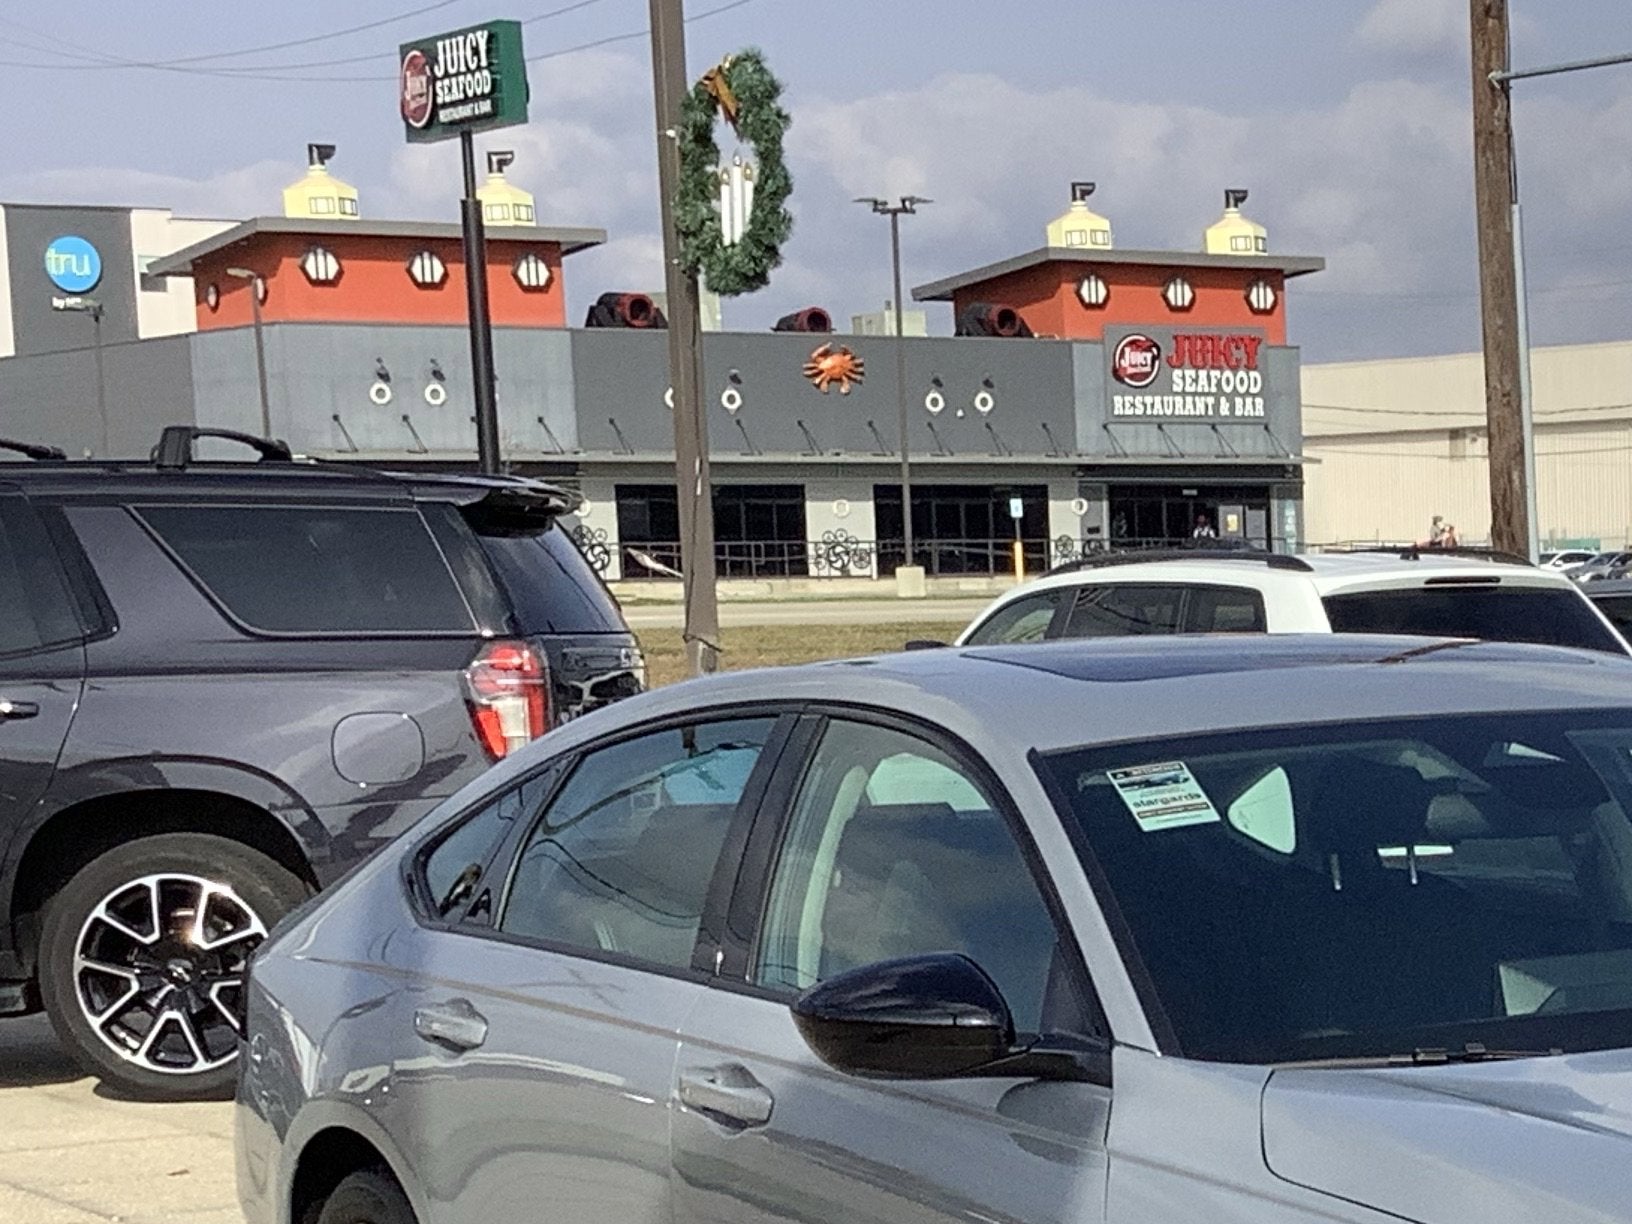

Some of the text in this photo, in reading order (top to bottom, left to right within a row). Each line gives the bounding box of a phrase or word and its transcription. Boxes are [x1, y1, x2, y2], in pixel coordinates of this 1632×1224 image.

[434, 30, 488, 78] JUICY
[436, 69, 491, 104] SEAFOOD
[48, 248, 91, 276] tru
[1166, 335, 1262, 369] JUICY
[1172, 369, 1262, 393] SEAFOOD
[1113, 395, 1265, 417] RESTAURANT & BAR
